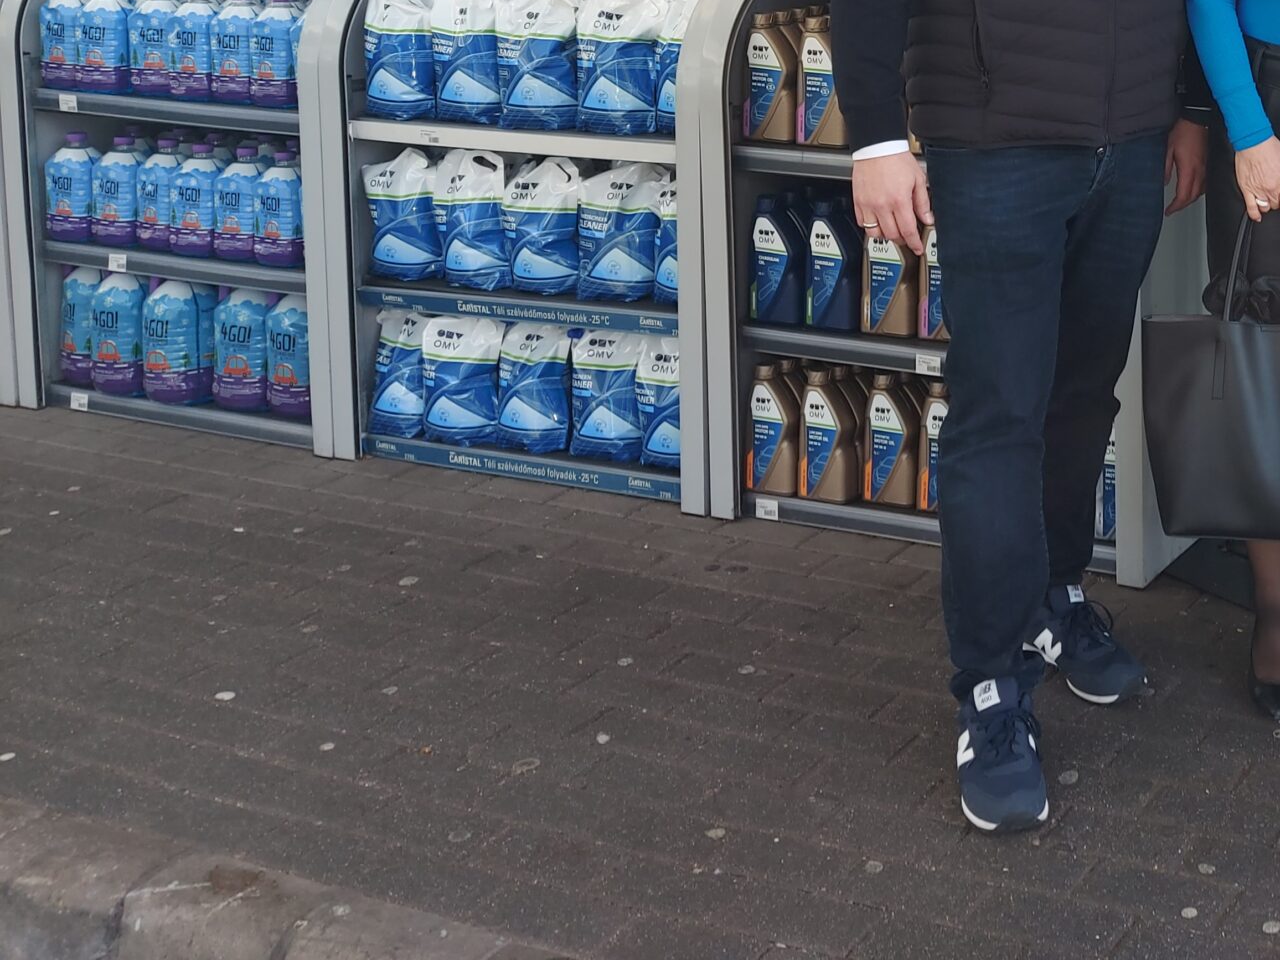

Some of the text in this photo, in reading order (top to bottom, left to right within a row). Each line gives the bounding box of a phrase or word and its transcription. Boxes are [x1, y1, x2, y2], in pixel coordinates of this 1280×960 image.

[46, 21, 65, 38] 4GO!
[82, 24, 105, 41] 4GO!
[593, 20, 621, 31] OMV
[139, 26, 163, 43] 4GO!
[176, 31, 196, 46] 4GO!
[216, 33, 240, 50] 4GO!
[255, 36, 274, 52] 4GO!
[752, 53, 769, 61] OMV
[806, 57, 824, 65] OMV
[52, 175, 72, 192] 4GO!
[100, 178, 119, 195] 4GO!
[140, 181, 158, 198] 4GO!
[178, 185, 200, 202] 4GO!
[219, 190, 240, 207] 4GO!
[511, 191, 537, 201] OMV
[260, 195, 280, 212] 4GO!
[759, 236, 775, 244] OMV
[814, 240, 831, 248] OMV
[873, 246, 889, 254] OMV
[93, 309, 118, 329] 4GO!
[457, 299, 491, 314] CARISTAL
[493, 305, 505, 315] Téli
[507, 306, 556, 320] szélvédőmosó
[557, 311, 588, 324] folyadék
[143, 319, 169, 339] 4GO!
[220, 321, 251, 344] 4GO!
[270, 330, 296, 352] 4GO!
[434, 340, 460, 351] OMV
[587, 348, 614, 359] OMV
[651, 364, 677, 375] OMV
[755, 404, 771, 413] OMV
[809, 411, 825, 420] OMV
[874, 414, 891, 423] OMV
[449, 451, 482, 467] CARISTAL
[484, 458, 496, 469] Téli
[497, 461, 546, 477] szélvédőmosó
[547, 467, 577, 482] folyadék
